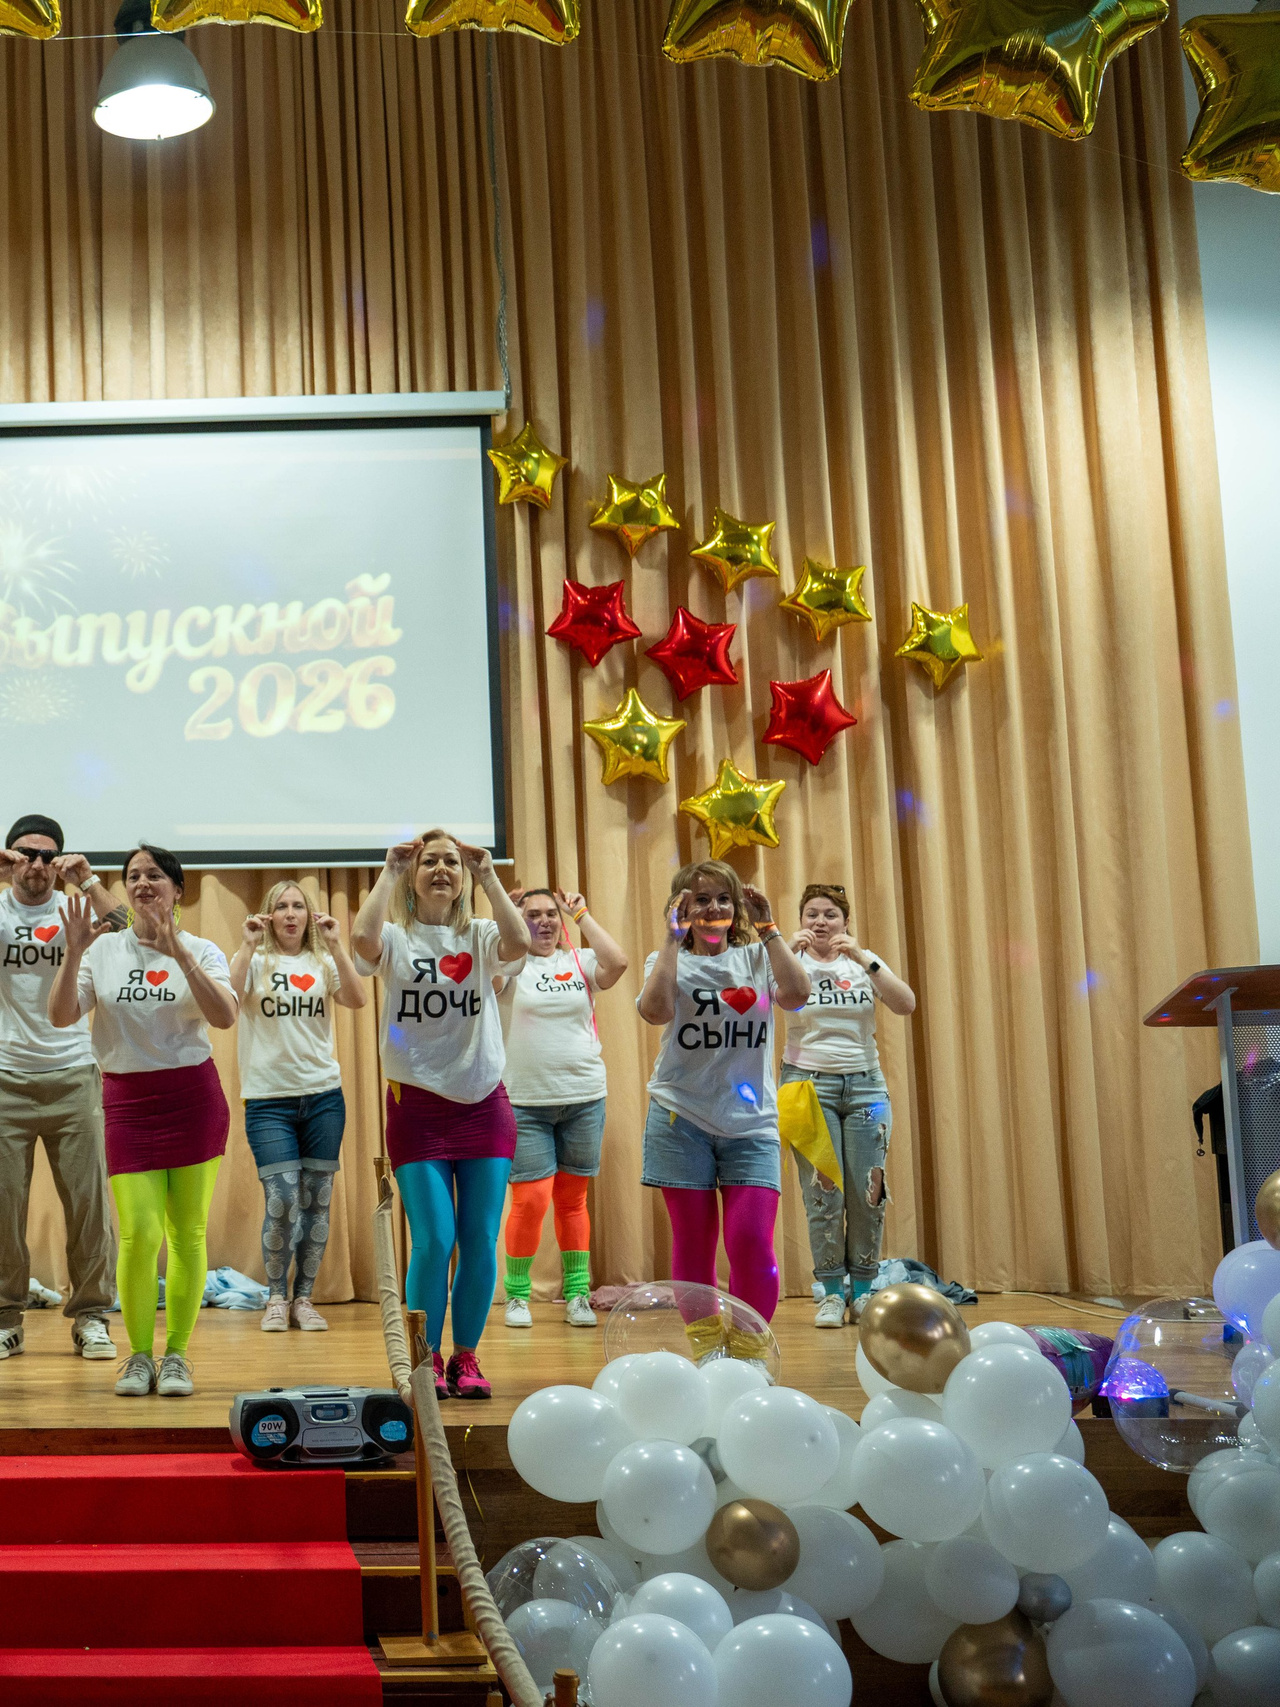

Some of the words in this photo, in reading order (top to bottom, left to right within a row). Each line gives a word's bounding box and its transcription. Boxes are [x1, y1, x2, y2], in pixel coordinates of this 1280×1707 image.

[184, 655, 396, 741] 2026
[14, 925, 32, 941] Я
[127, 969, 144, 985] Я
[412, 957, 437, 983] Я
[271, 971, 289, 991] Я
[819, 979, 832, 991] Я
[116, 987, 176, 1003] ДОЧЬ
[692, 988, 720, 1016] Я
[261, 996, 325, 1018] СЫНА
[397, 989, 481, 1023] ДОЧЬ
[677, 1021, 767, 1050] СЫНА
[261, 1421, 283, 1431] 90W
